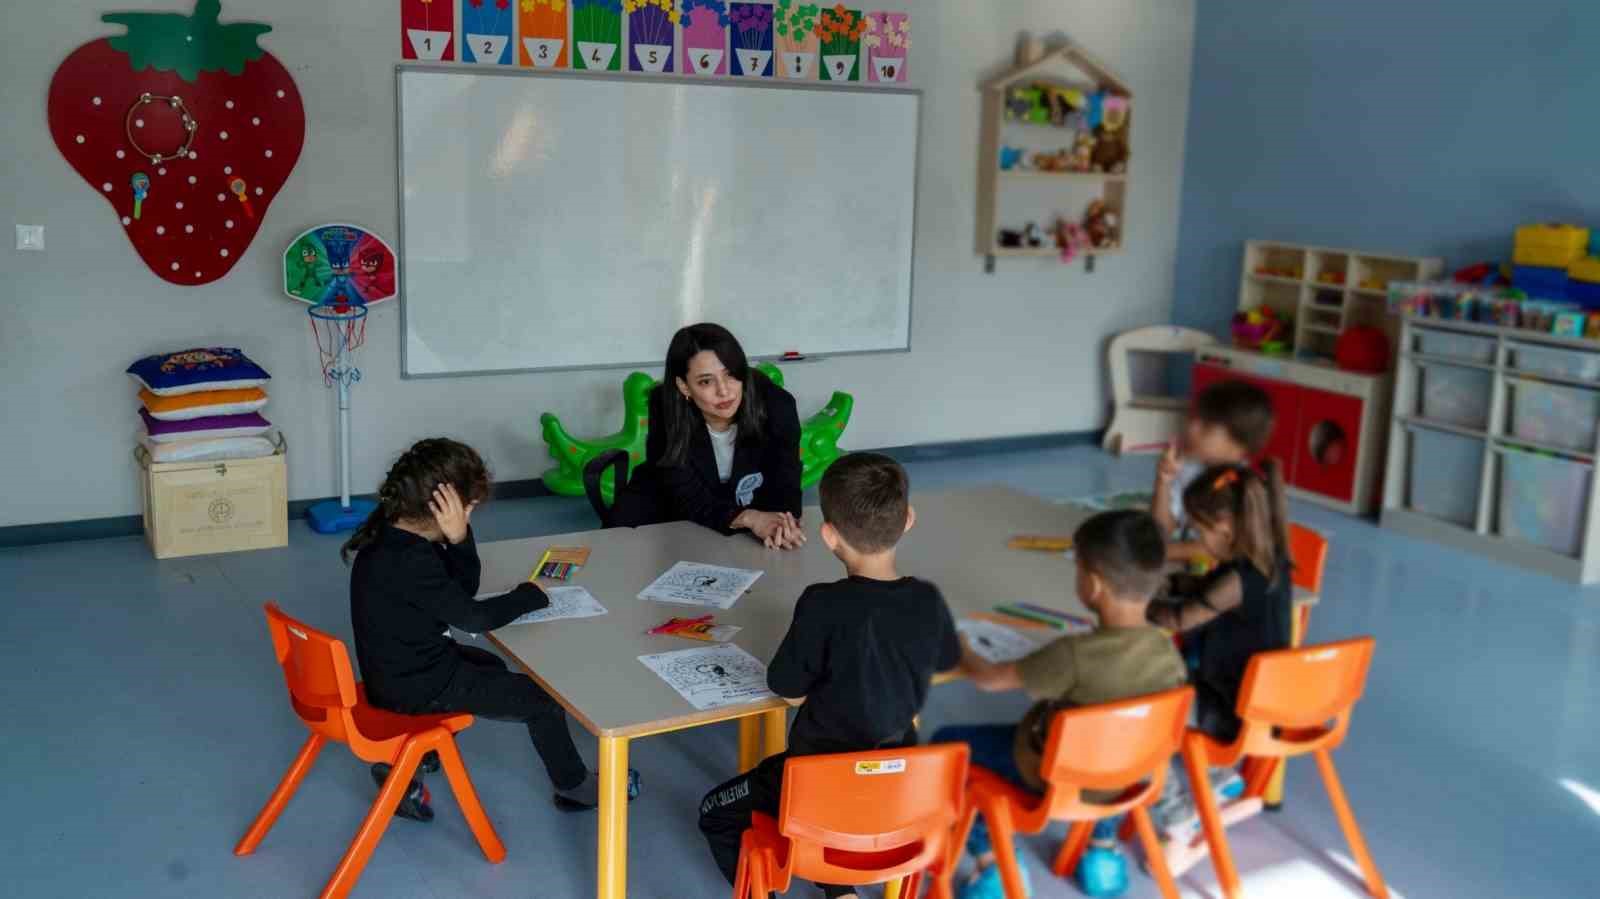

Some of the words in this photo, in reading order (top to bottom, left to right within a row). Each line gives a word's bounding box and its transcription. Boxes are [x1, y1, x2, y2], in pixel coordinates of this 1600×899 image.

[424, 38, 431, 51] 1
[483, 41, 493, 54] 2
[538, 44, 548, 58] 3
[592, 48, 601, 63] 4
[648, 51, 657, 64] 5
[699, 54, 710, 69] 6
[749, 57, 759, 71] 7
[836, 61, 845, 75] 9
[881, 65, 895, 78] 10
